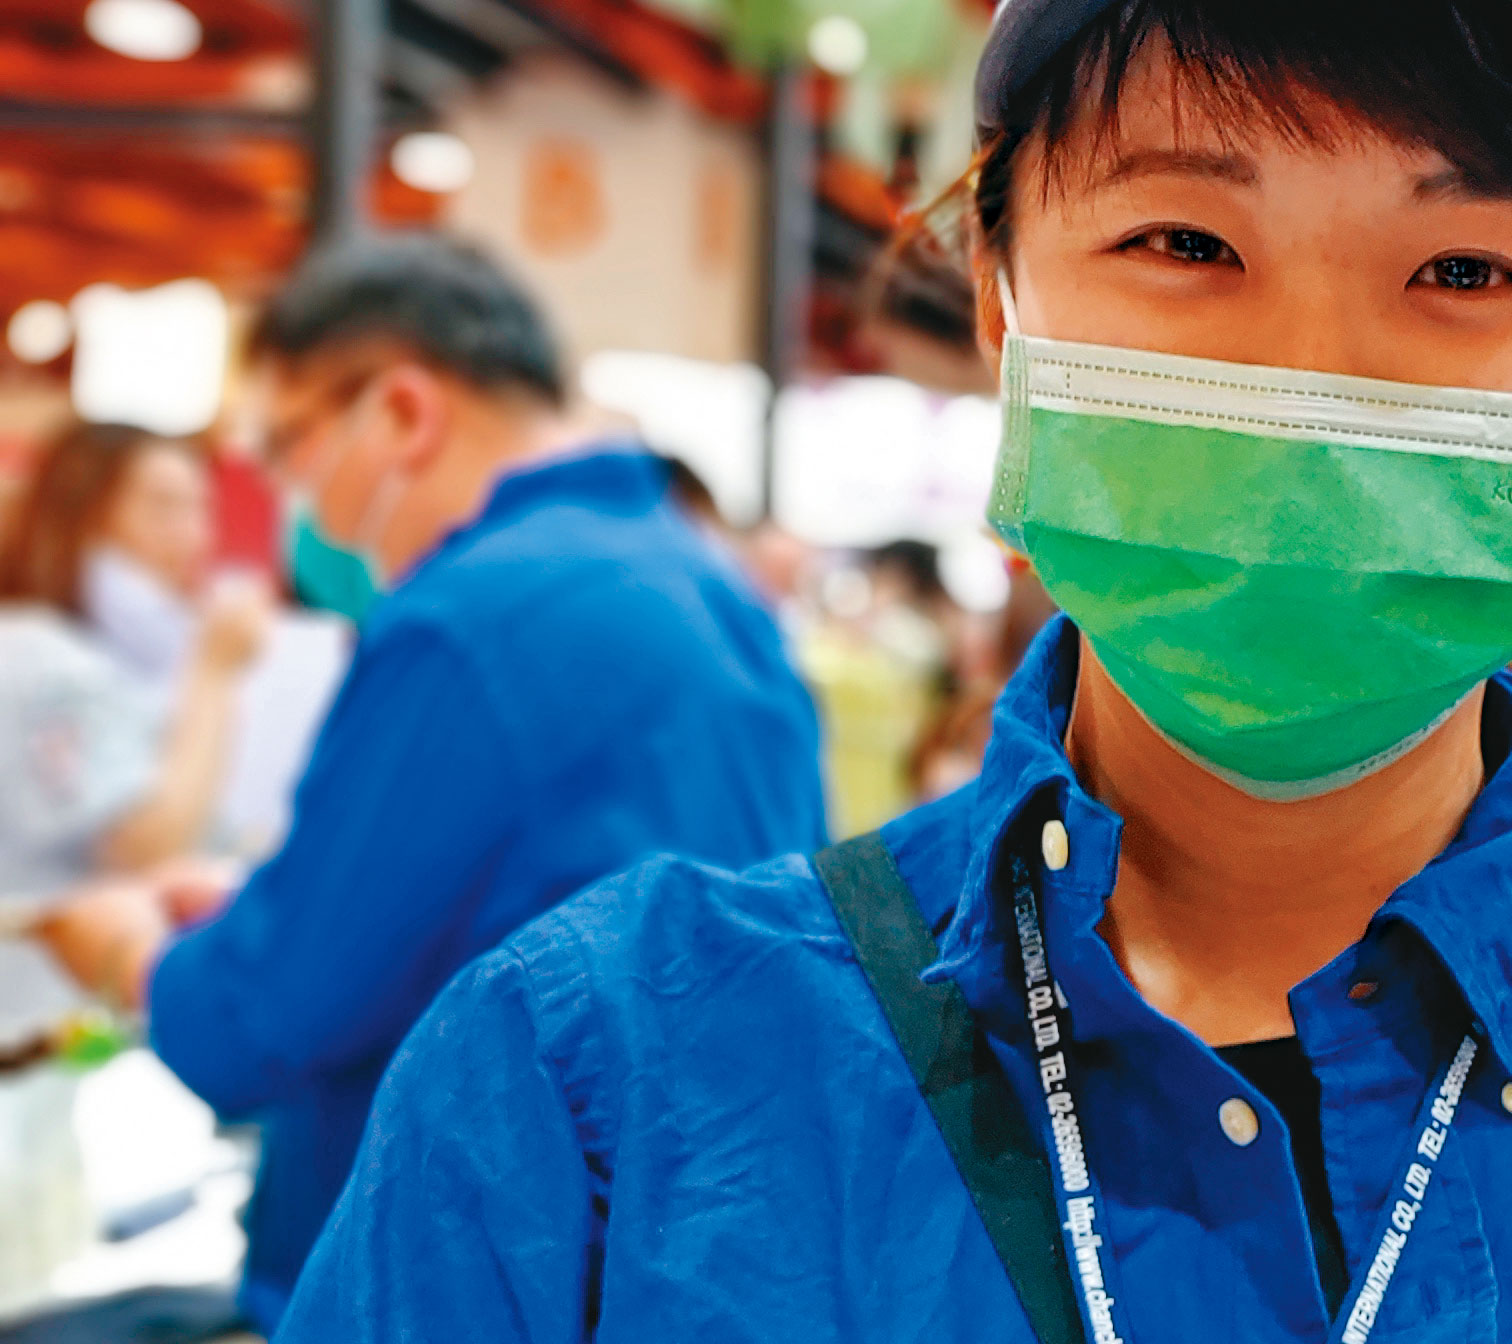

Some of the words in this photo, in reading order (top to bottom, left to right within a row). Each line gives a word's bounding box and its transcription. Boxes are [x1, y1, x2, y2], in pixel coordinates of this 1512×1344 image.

[1040, 1052, 1066, 1093] TEL:
[1404, 1163, 1431, 1200] LTD.
[1418, 1121, 1448, 1160] TEL:
